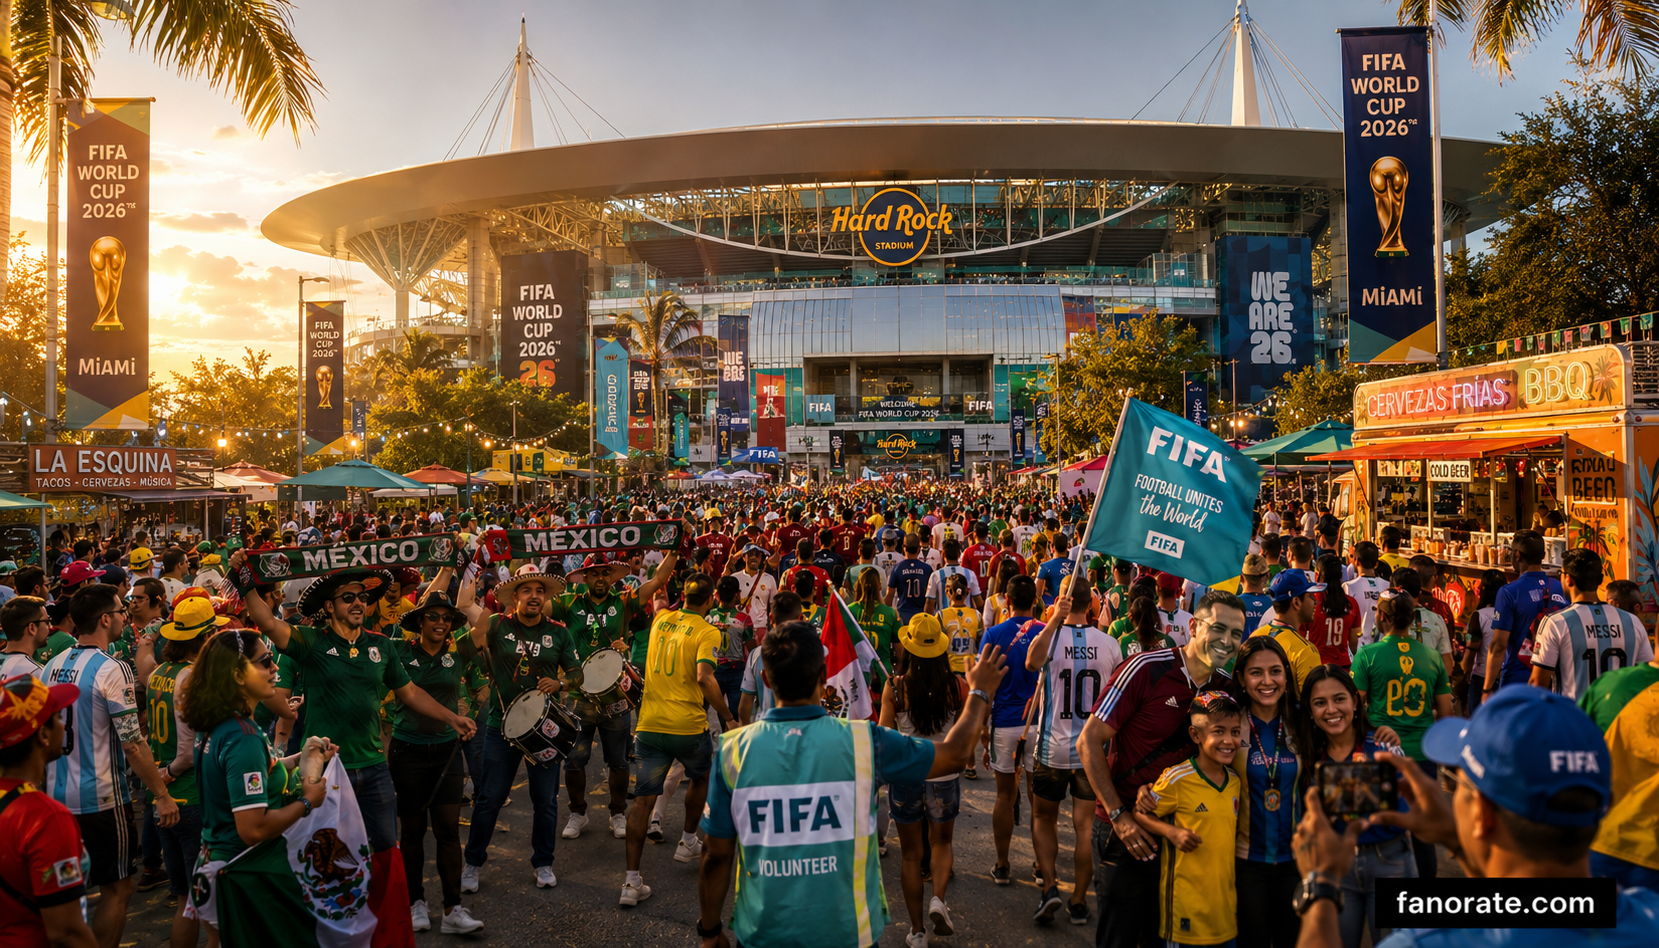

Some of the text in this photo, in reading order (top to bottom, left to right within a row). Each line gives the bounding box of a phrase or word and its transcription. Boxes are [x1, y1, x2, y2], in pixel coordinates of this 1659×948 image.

[1362, 53, 1406, 71] FIFA
[1351, 76, 1420, 95] WORLD
[1366, 98, 1406, 116] CUP
[88, 144, 128, 160] FIFA
[77, 164, 140, 180] WORLD
[90, 183, 126, 200] CUP
[830, 203, 953, 237] Hard Rock
[875, 241, 914, 250] STADIUM
[519, 283, 555, 301] FIFA
[1250, 271, 1291, 302] WE
[512, 303, 563, 321] WORLD
[1248, 301, 1294, 331] ARE
[315, 321, 334, 330] FIFA
[523, 322, 553, 338] CUP
[310, 331, 340, 340] WORLD
[316, 340, 333, 348] CUP
[1250, 330, 1293, 365] 26
[519, 360, 556, 388] 26
[1367, 361, 1591, 418] CERVEZAS FRÍAS BBQ
[808, 402, 833, 413] FIFA
[968, 400, 994, 411] FIFA
[35, 449, 173, 475] LA ESQUINA
[1146, 425, 1227, 484] FIFA
[1430, 464, 1449, 478] COLD
[36, 477, 71, 488] TACOS
[82, 477, 131, 488] CERVEZAS
[1134, 473, 1224, 514] FOOTBALL UNITES
[1139, 494, 1208, 533] the World
[1150, 535, 1178, 554] FIFA
[1585, 624, 1621, 639] MESSI
[1064, 645, 1099, 660] MESSI
[1058, 668, 1102, 720] 10
[1549, 750, 1601, 774] FIFA
[747, 794, 842, 835] FIFA
[758, 855, 838, 877] VOLUNTEER
